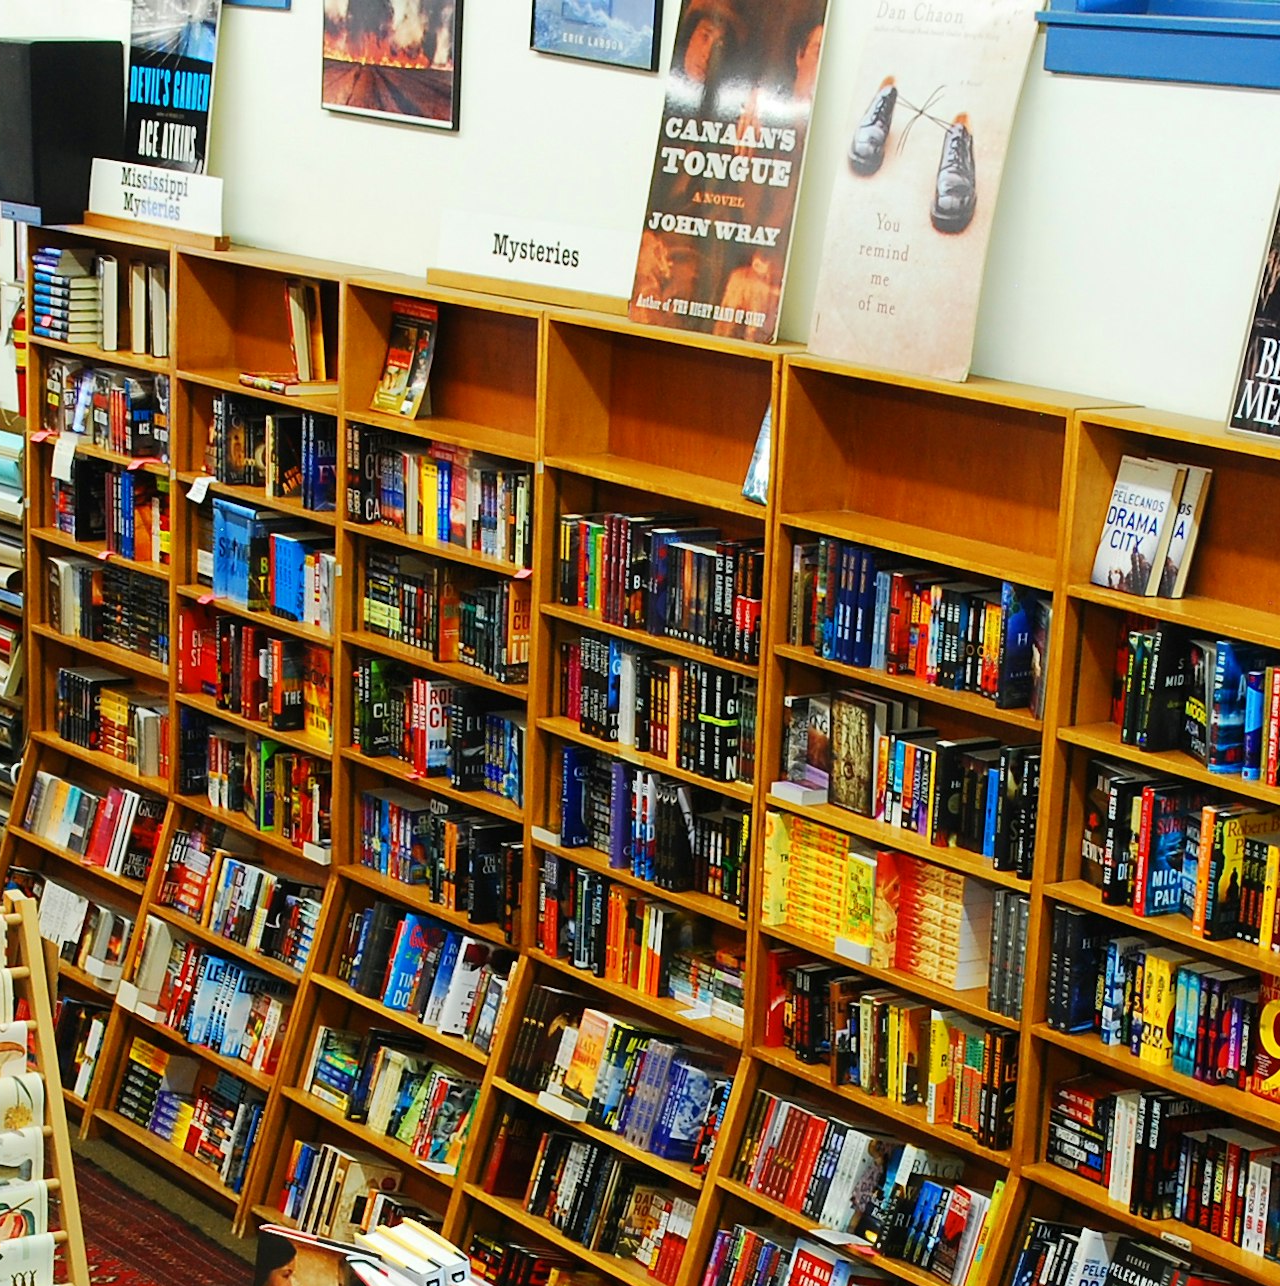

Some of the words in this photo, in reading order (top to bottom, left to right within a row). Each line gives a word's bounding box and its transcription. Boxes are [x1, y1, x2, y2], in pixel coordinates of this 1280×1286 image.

[876, 0, 908, 22] Dan
[913, 4, 965, 25] Chaon
[562, 31, 585, 46] ERIK
[587, 35, 625, 52] LARSON
[130, 65, 170, 106] DEVIL'S
[137, 119, 160, 157] ACE
[161, 122, 196, 164] ATKINS
[665, 116, 796, 154] CANAAN'S
[660, 146, 793, 189] TONGUE
[120, 166, 189, 200] Mississippi
[123, 191, 181, 222] Mysteries
[691, 191, 702, 203] A
[703, 193, 745, 209] NOVEL
[648, 212, 711, 238] JOHN
[713, 220, 781, 249] WRAY
[875, 212, 902, 233] You
[492, 232, 580, 269] Mysteries
[859, 241, 910, 263] remind
[870, 271, 890, 287] me
[858, 297, 872, 314] of
[876, 301, 896, 316] me
[1112, 488, 1166, 514] PELECANOS
[1106, 505, 1159, 538] DRAMA
[1109, 529, 1144, 554] CITY
